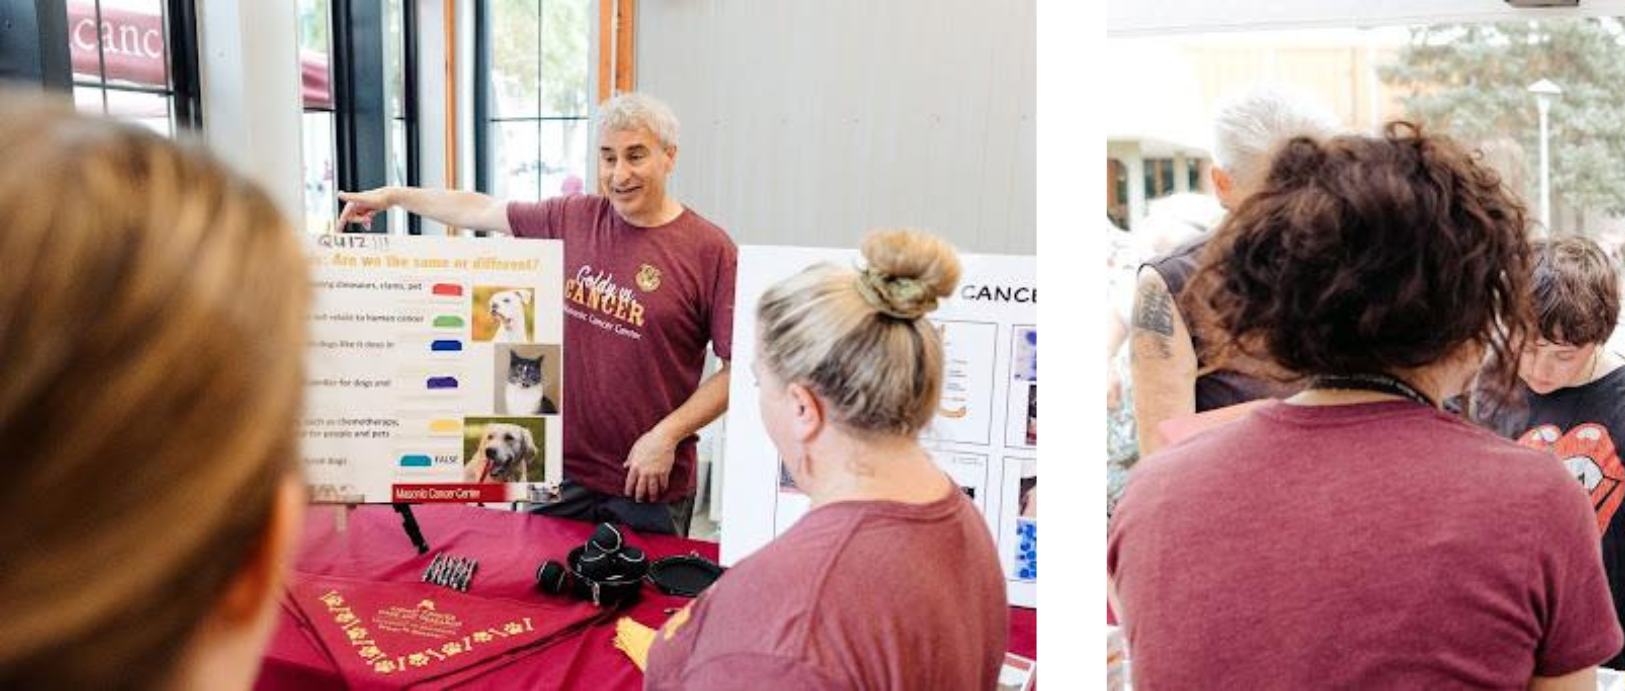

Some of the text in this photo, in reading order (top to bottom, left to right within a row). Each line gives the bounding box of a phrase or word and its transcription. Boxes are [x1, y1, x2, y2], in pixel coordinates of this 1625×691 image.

[362, 257, 381, 267] we
[453, 260, 467, 268] or
[565, 279, 645, 327] CANCER
